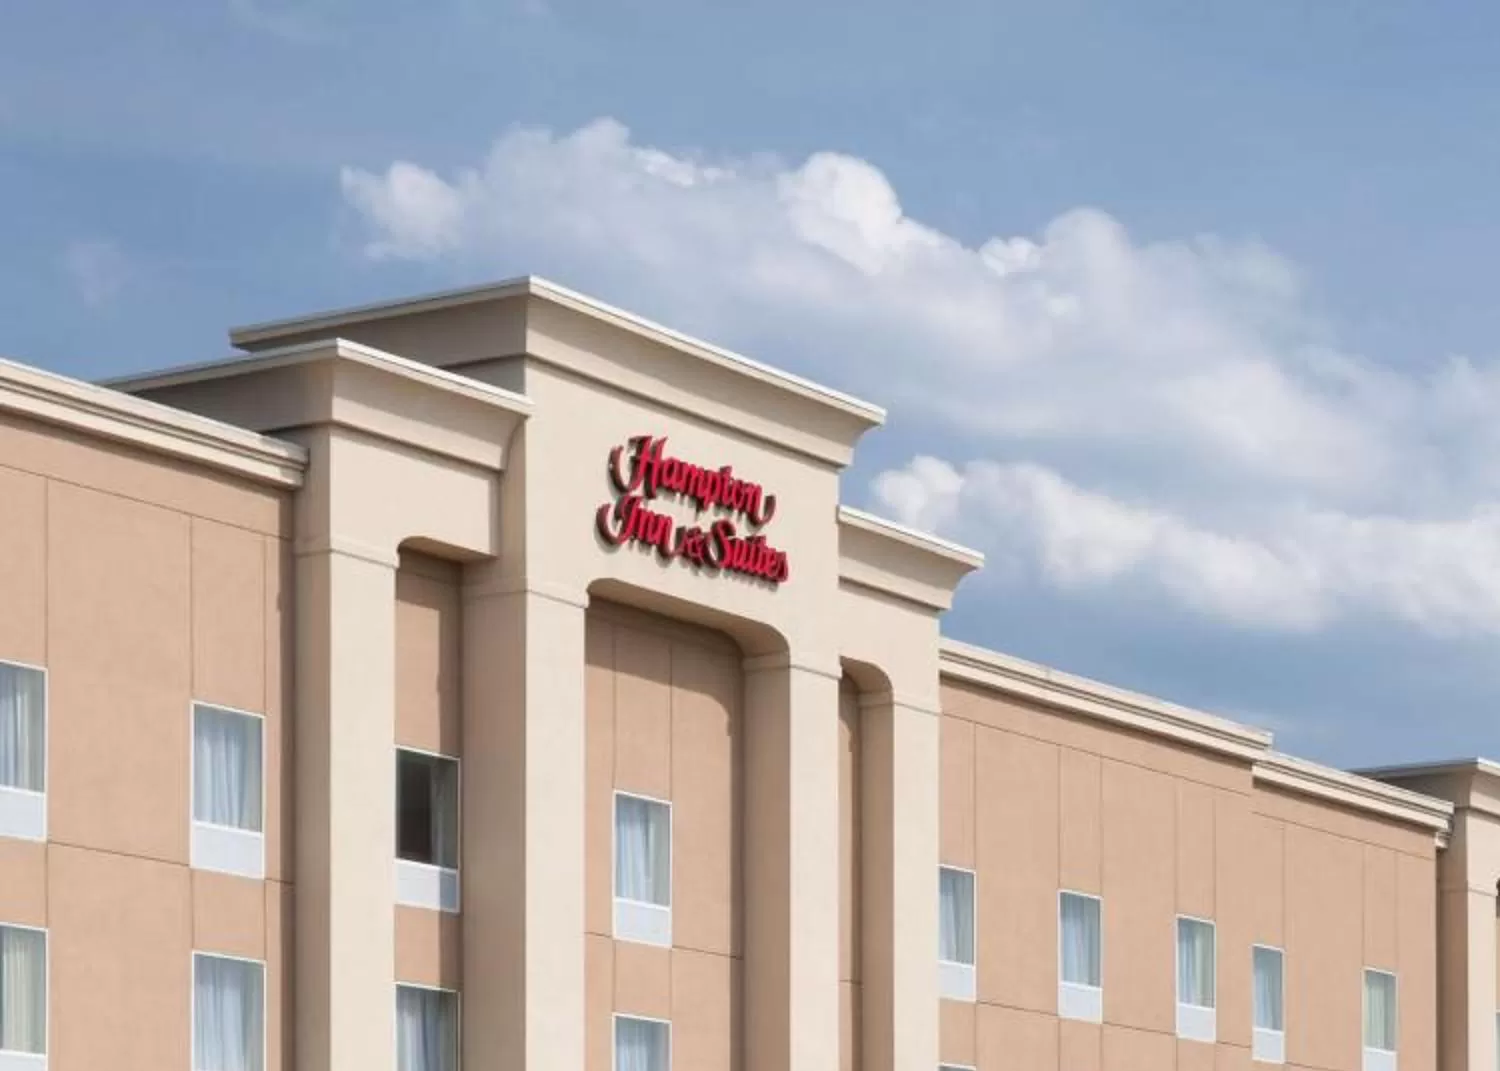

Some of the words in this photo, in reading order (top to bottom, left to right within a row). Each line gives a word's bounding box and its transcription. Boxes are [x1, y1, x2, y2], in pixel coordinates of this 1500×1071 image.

[608, 435, 776, 526] Hampton
[596, 495, 687, 557] Inn
[701, 519, 789, 583] Suites
